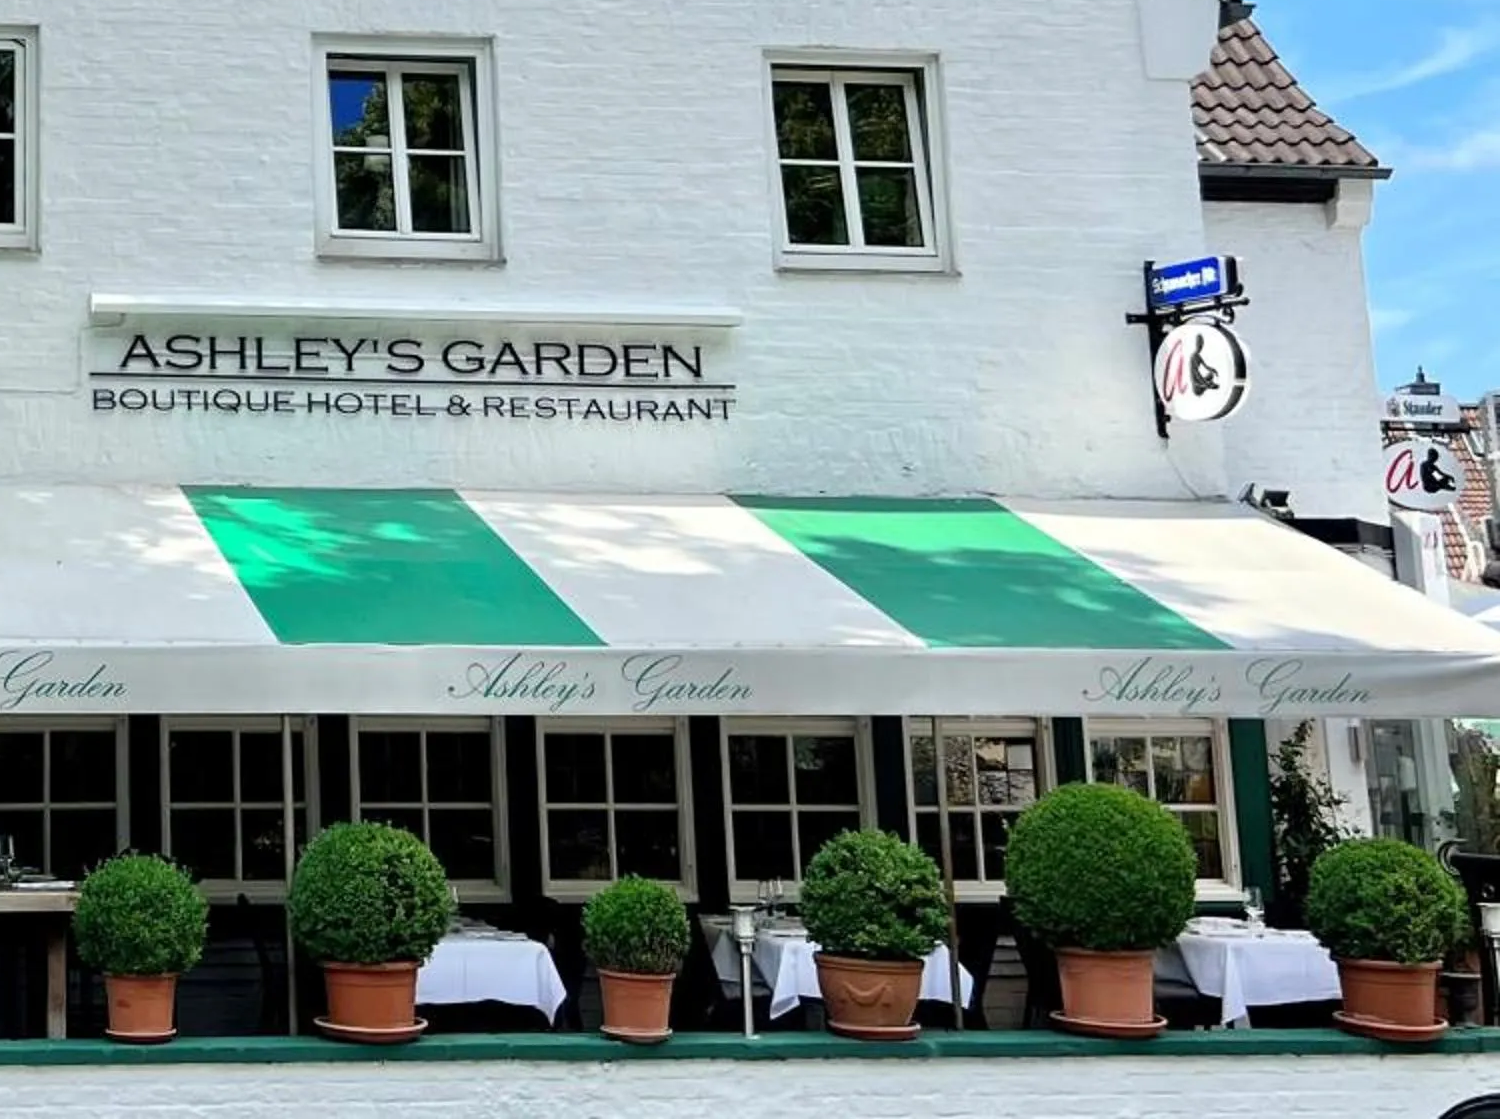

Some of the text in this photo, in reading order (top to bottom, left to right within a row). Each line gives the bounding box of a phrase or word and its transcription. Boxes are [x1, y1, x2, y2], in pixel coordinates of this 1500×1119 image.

[119, 334, 702, 379] ASHLEY'S GARDEN
[92, 388, 737, 423] BOUTIQUE HOTEL & RESTAURANT
[447, 652, 753, 712] Ashley's Garden
[1081, 655, 1373, 714] Ashley's Garden
